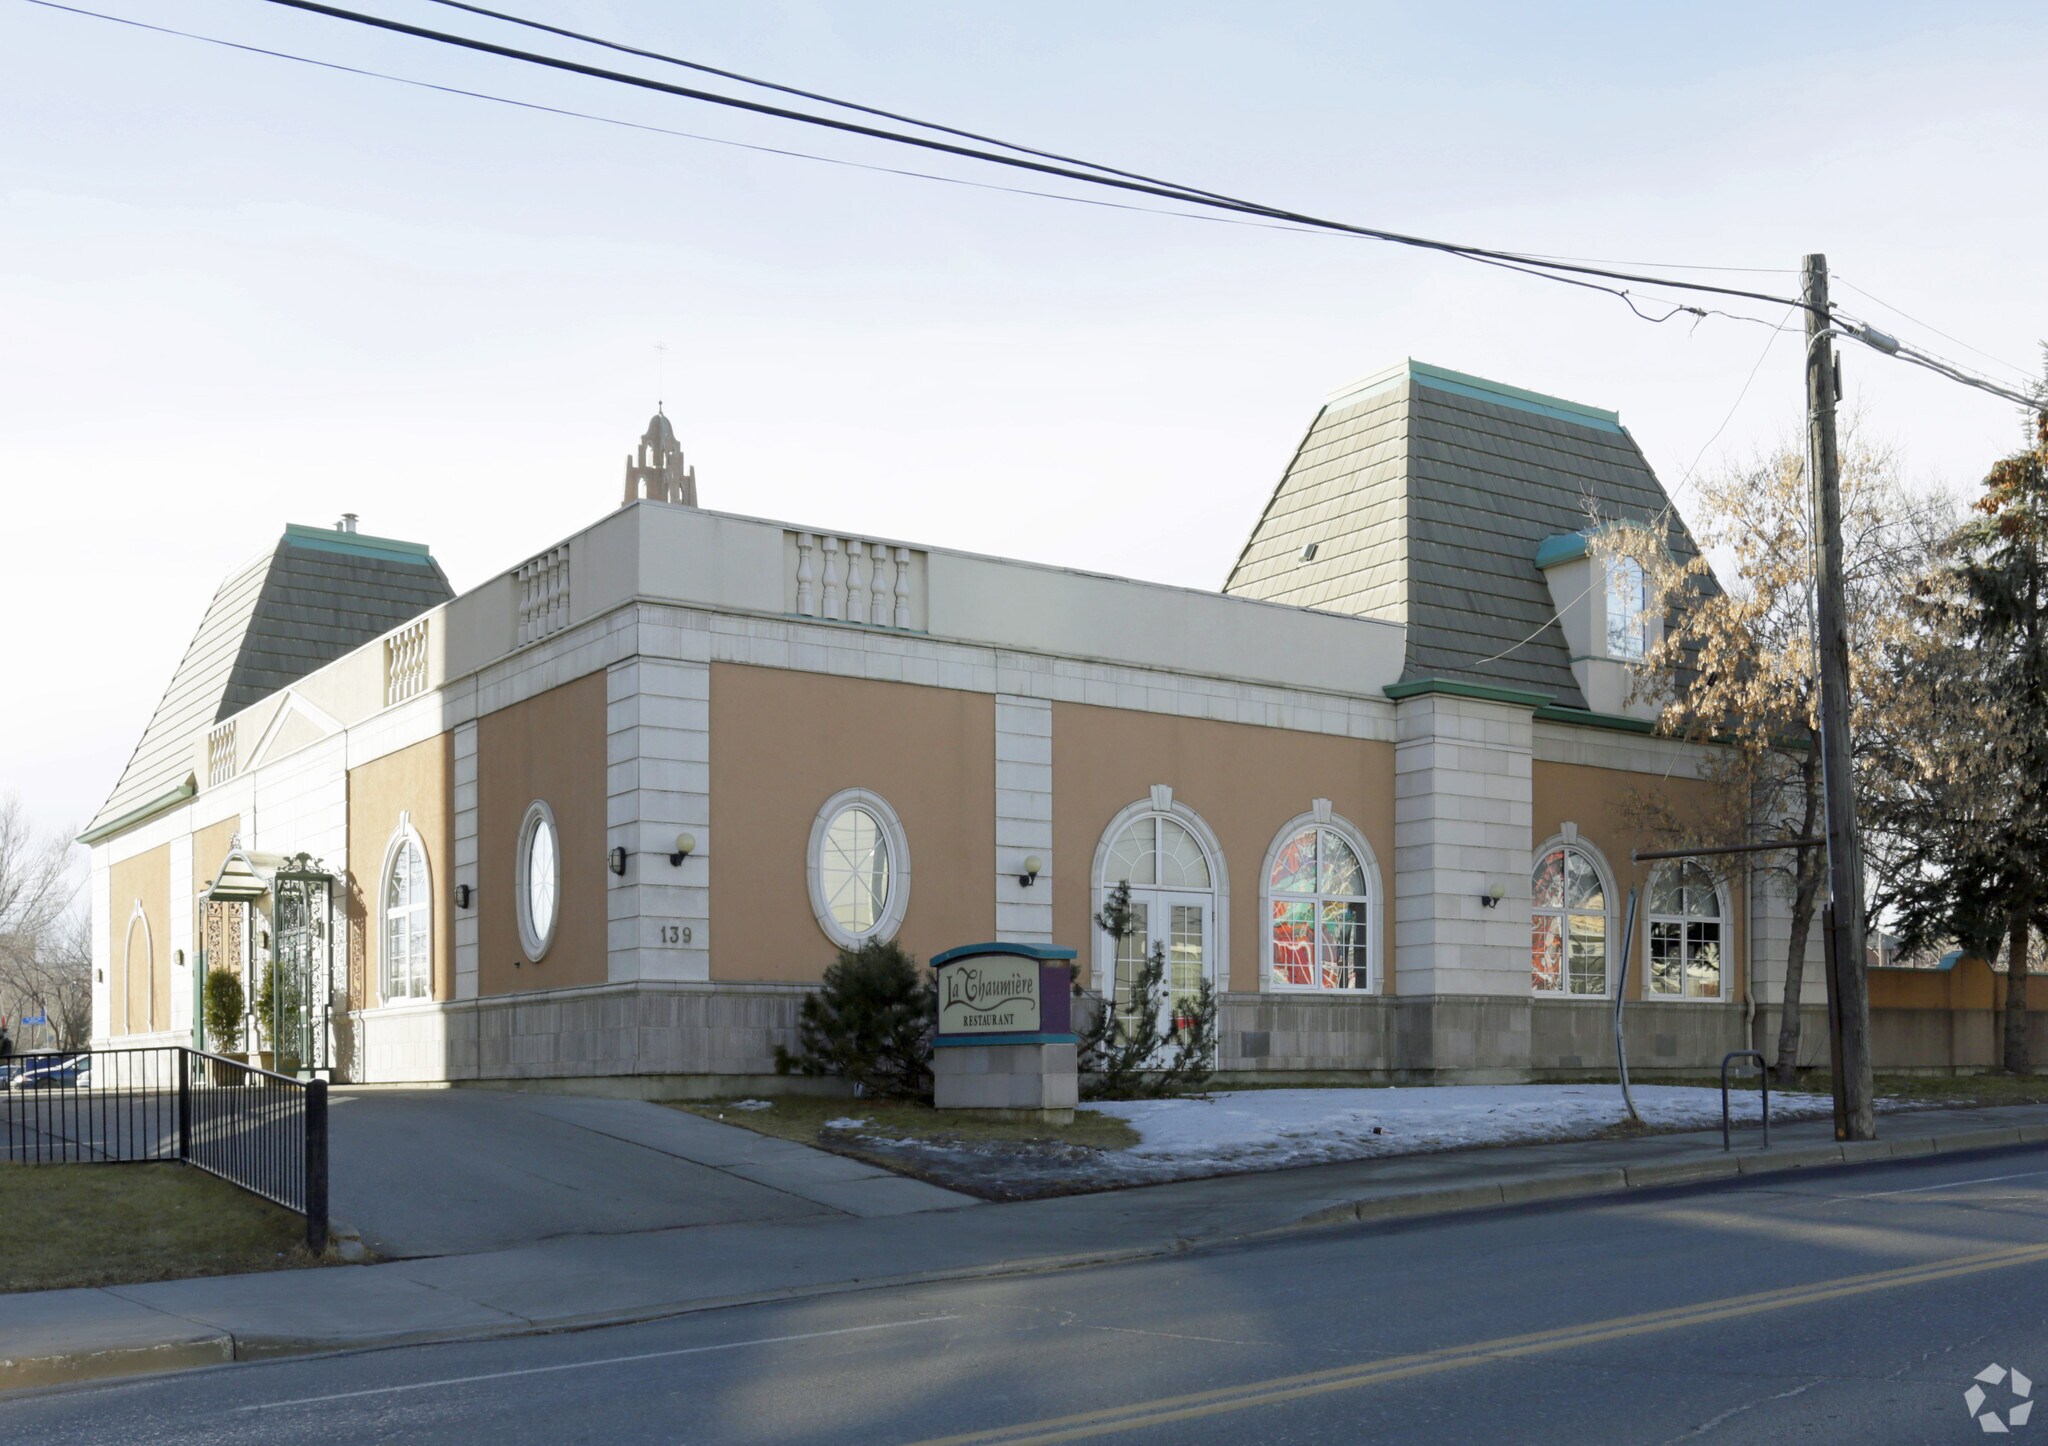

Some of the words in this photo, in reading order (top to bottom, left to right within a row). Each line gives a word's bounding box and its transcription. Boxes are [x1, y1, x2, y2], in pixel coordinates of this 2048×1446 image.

[661, 926, 692, 943] 139
[944, 975, 959, 1011] La
[957, 967, 1033, 1002] Chaumière
[963, 1014, 1014, 1026] RESTAURANT
